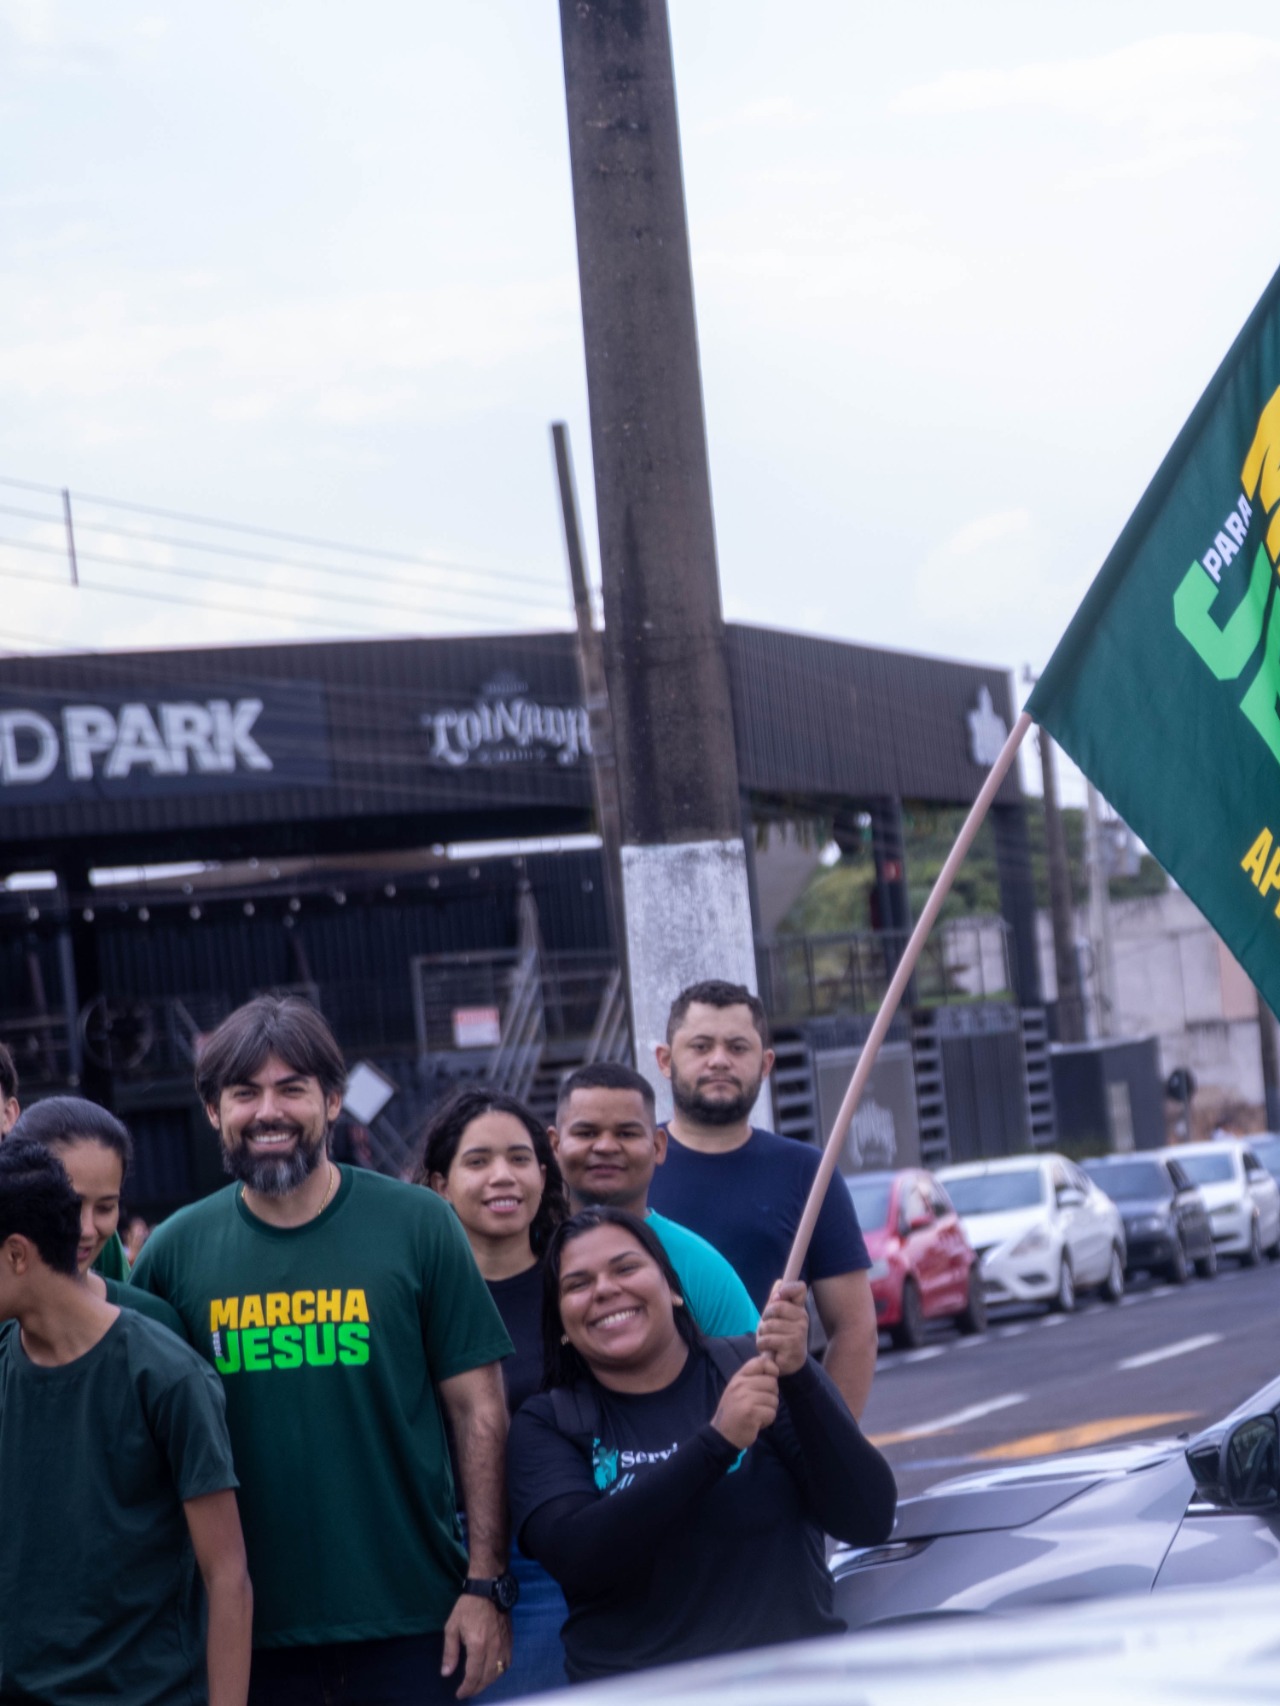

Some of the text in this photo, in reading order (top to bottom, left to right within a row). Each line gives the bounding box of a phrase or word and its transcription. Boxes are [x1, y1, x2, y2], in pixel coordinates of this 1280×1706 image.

[1202, 492, 1253, 583] PARA
[61, 698, 274, 782] PARK
[210, 1288, 370, 1333] MARCHA
[215, 1322, 370, 1374] JESUS
